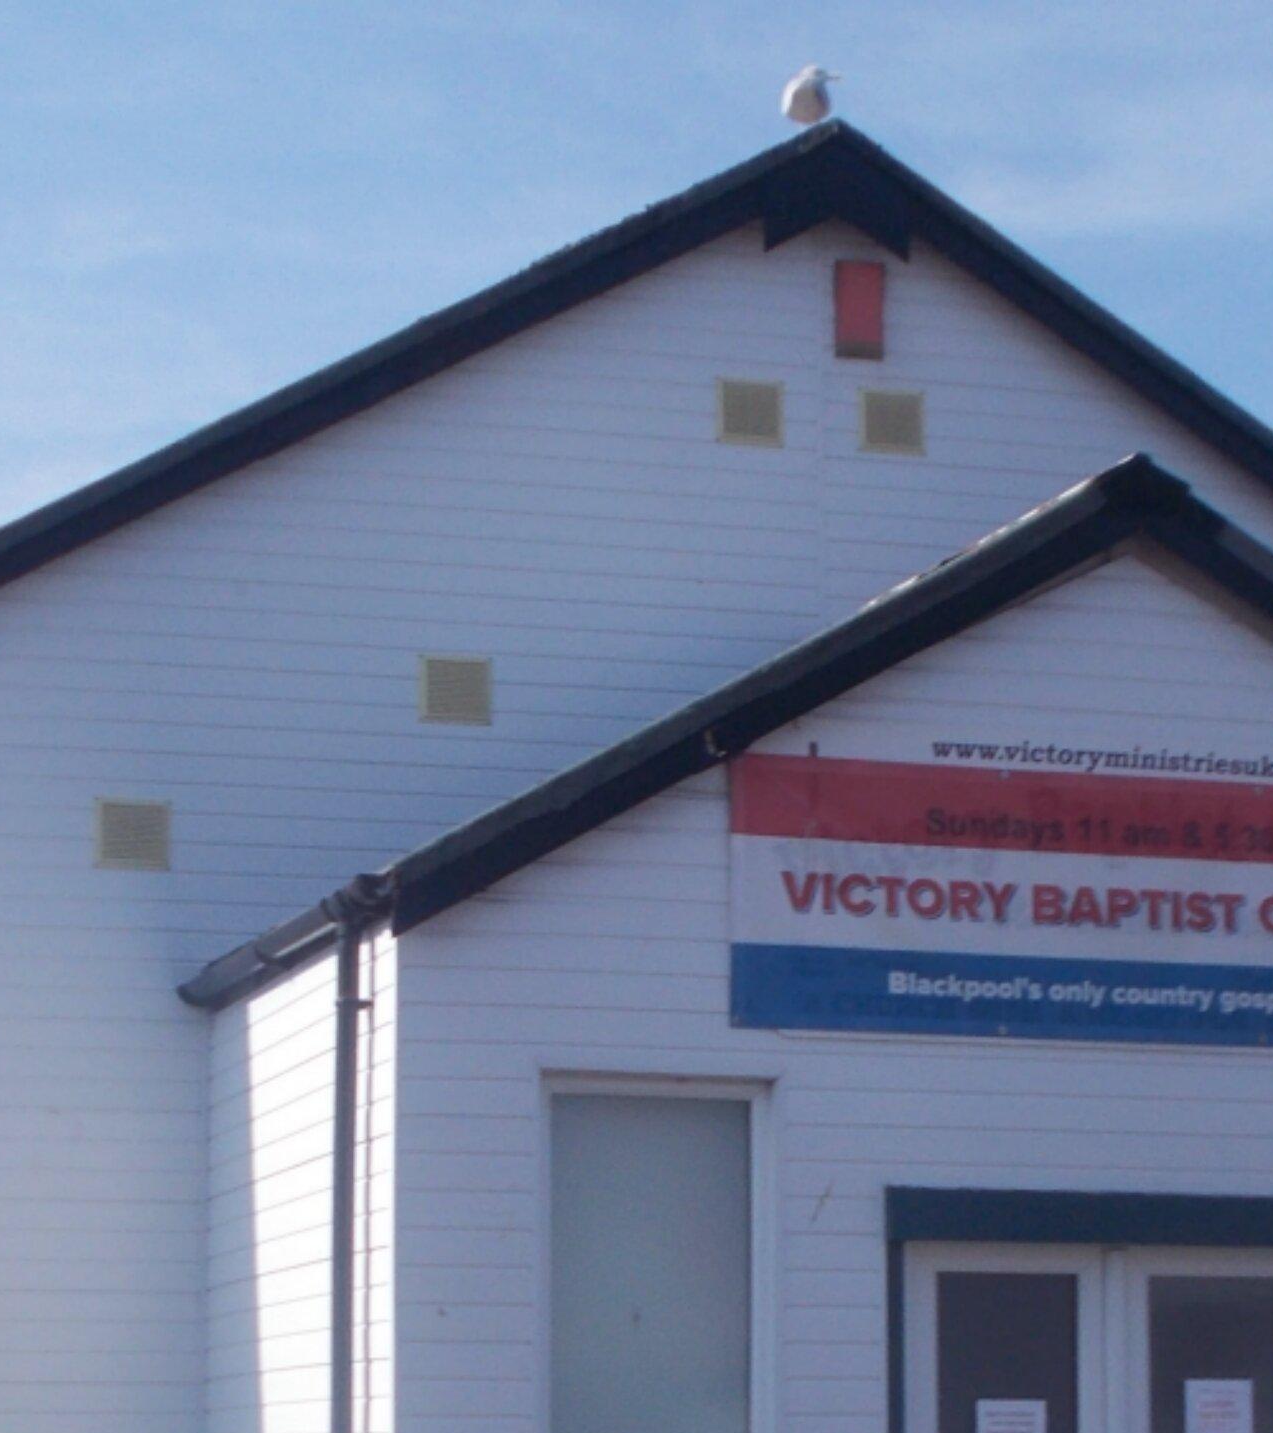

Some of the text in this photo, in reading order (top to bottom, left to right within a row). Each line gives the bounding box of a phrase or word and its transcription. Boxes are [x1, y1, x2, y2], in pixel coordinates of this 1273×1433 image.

[926, 806, 1065, 849] Sundays
[1078, 815, 1111, 844] 11
[1122, 820, 1170, 847] am
[1181, 820, 1203, 849] &
[781, 870, 1016, 925] VICTORY
[1032, 883, 1244, 934] BAPTIST
[887, 970, 1041, 1003] Blackpool's
[1050, 981, 1106, 1009] only
[1112, 983, 1213, 1013] country
